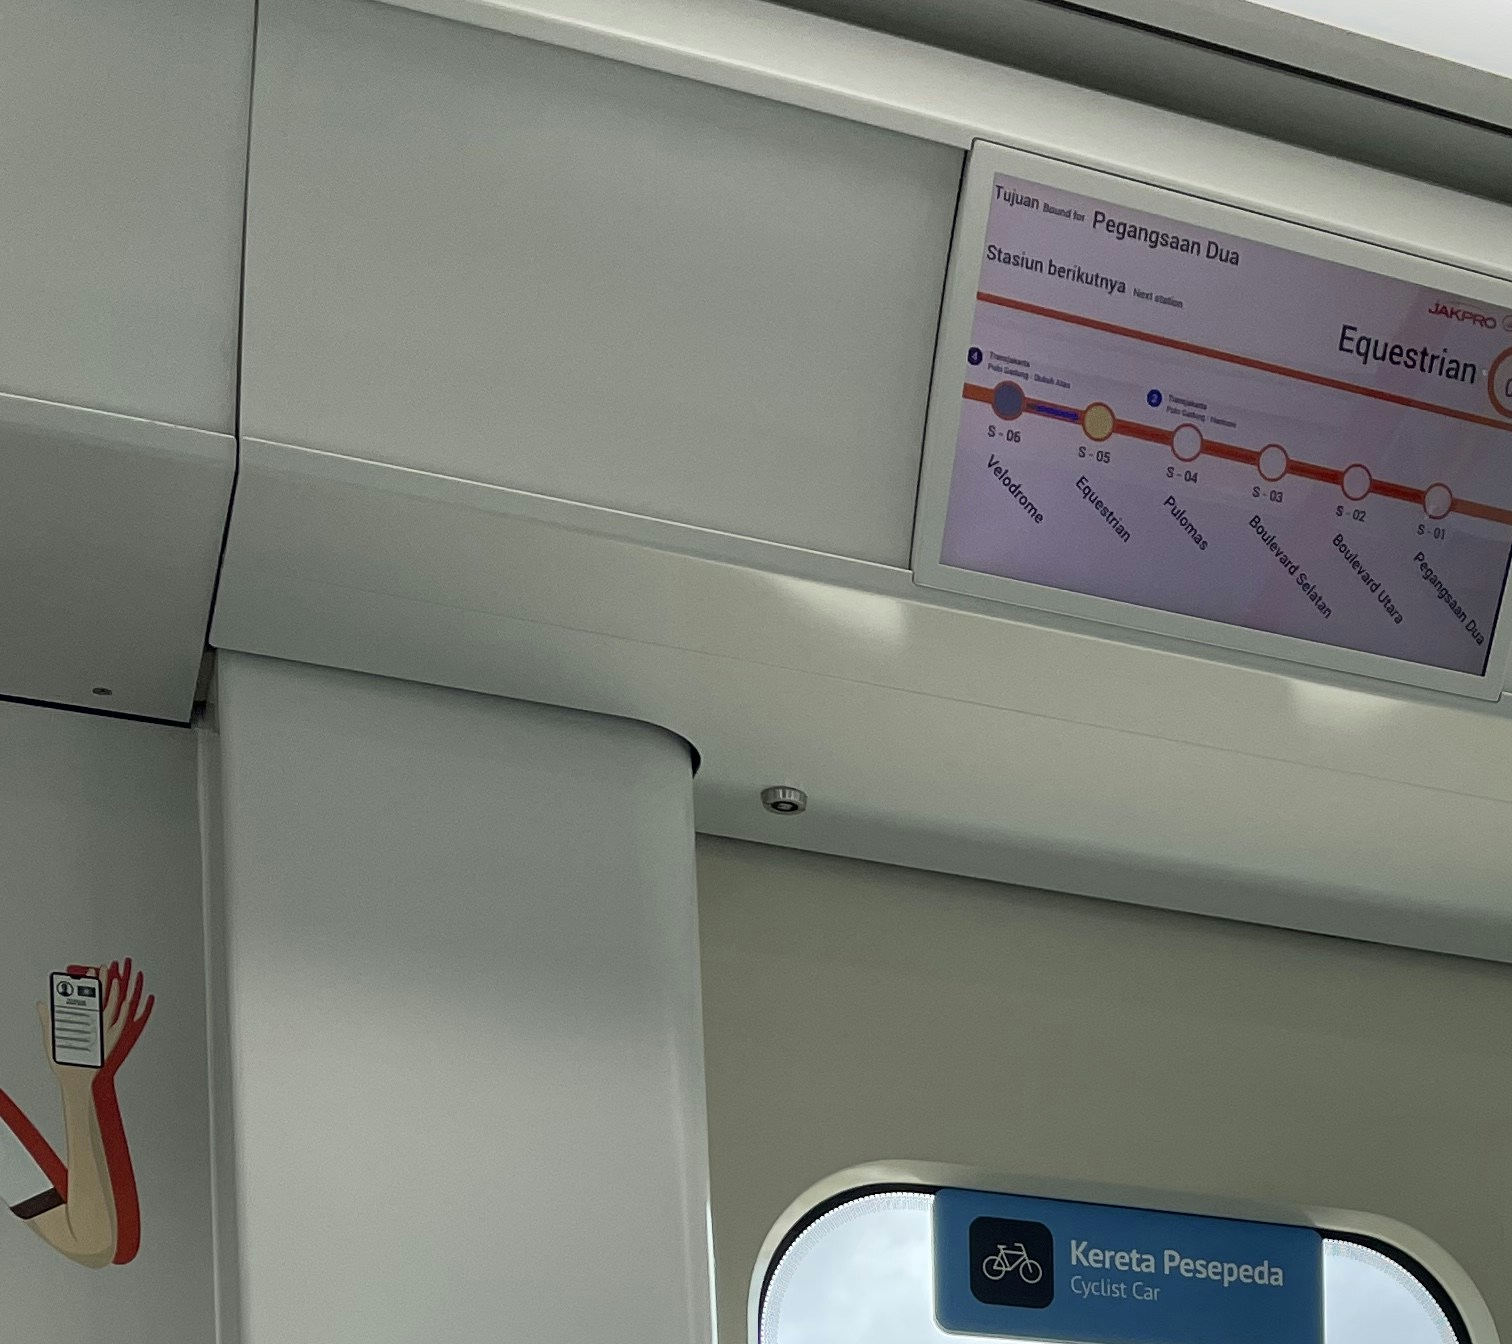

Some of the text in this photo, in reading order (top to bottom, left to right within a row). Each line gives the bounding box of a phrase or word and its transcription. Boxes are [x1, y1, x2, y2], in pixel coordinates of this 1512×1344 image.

[994, 184, 1240, 266] Tujuan Bound for Pegangsaan Dua
[986, 244, 1044, 274] Stasiun
[1048, 258, 1126, 296] berikutnya
[1428, 302, 1498, 330] JAKPRO
[1338, 324, 1478, 384] Equestrian
[1006, 428, 1022, 444] 06
[1096, 450, 1112, 464] 05
[986, 454, 1044, 524] Velodrome
[1184, 470, 1198, 484] 04
[1270, 490, 1284, 504] 03
[1076, 476, 1131, 543] Equestrian
[1162, 495, 1209, 551] Pulomas
[1352, 510, 1366, 522] 02
[1434, 528, 1446, 540] 01
[1248, 514, 1332, 620] Boulevard Selatan
[1332, 533, 1404, 626] Boulevard Utara
[1413, 551, 1485, 646] Pegangsaan Dua
[1070, 1240, 1284, 1288] Kereta Pesepeda
[1070, 1275, 1161, 1302] Cyclist Car
